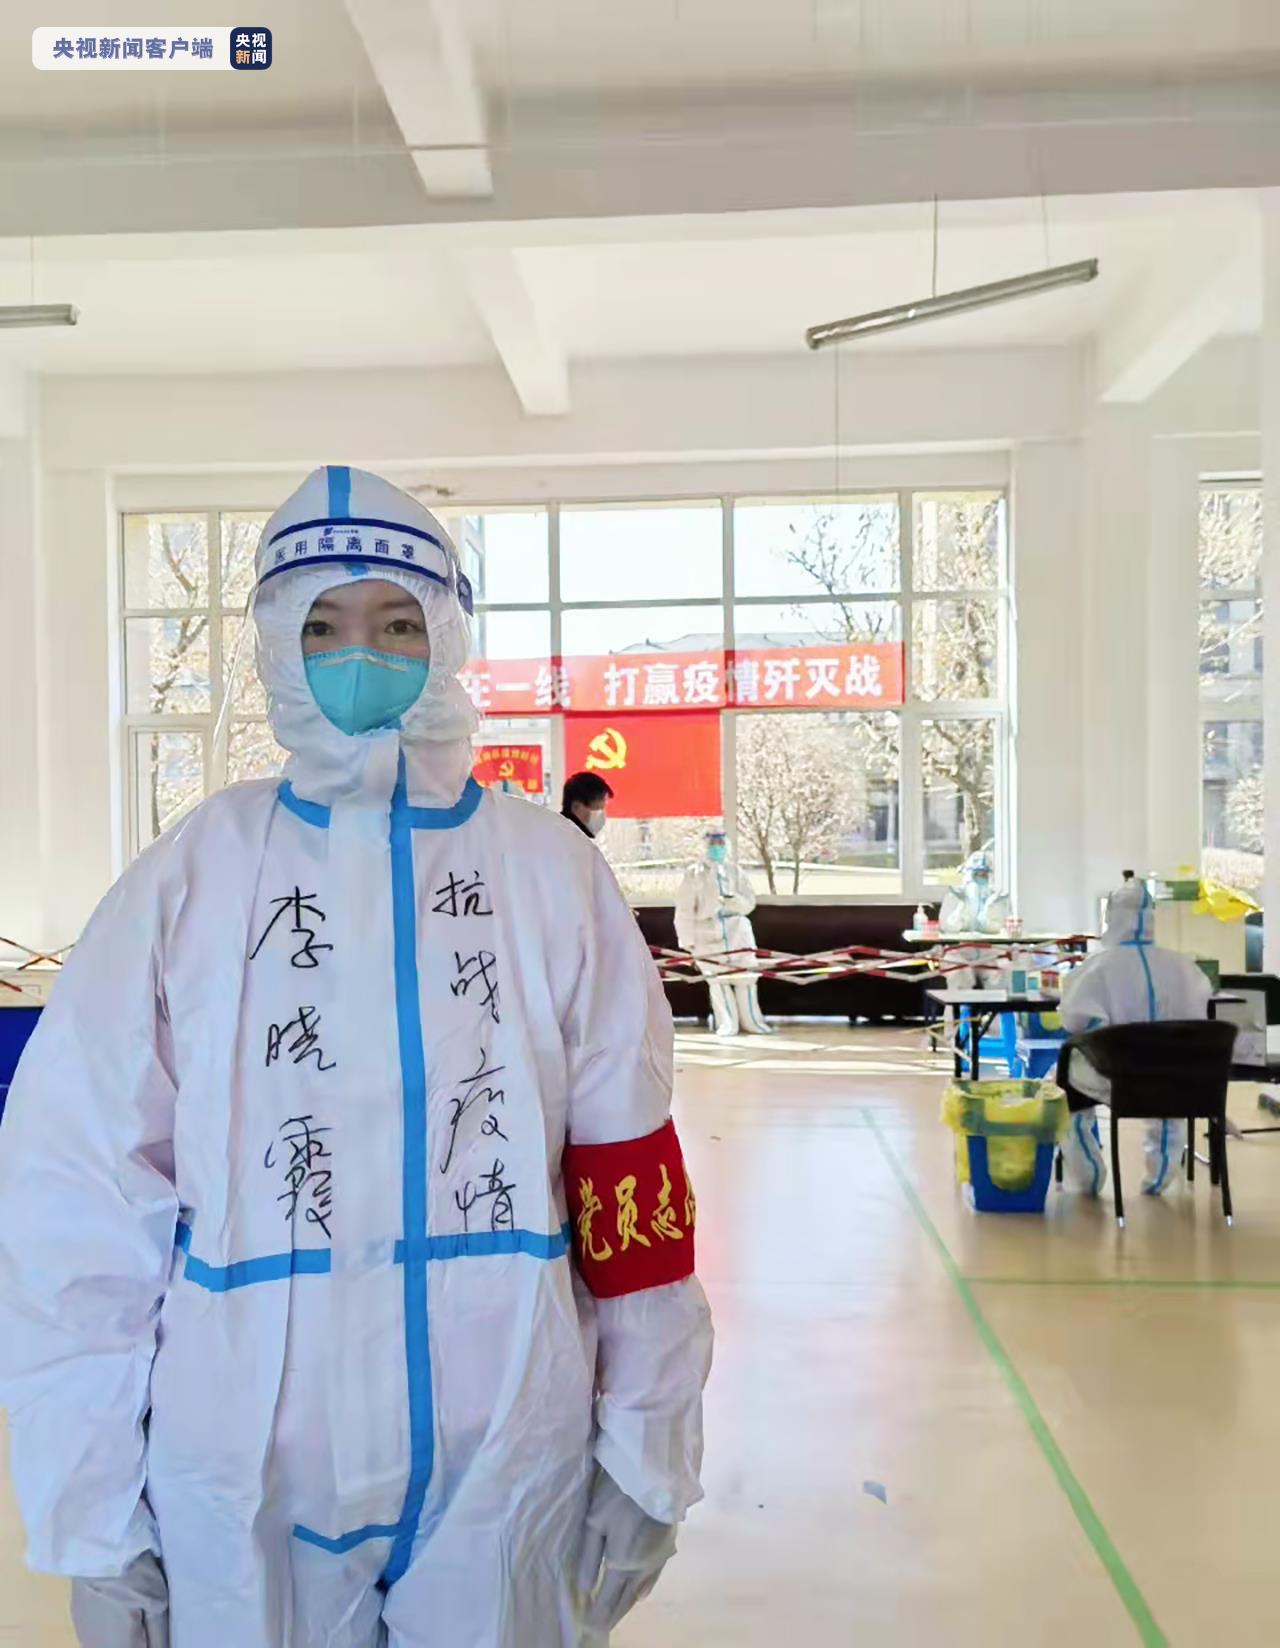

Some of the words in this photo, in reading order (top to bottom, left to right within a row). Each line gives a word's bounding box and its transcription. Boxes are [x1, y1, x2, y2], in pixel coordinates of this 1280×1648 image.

[275, 535, 415, 564] 医用隔离面罩
[604, 654, 883, 706] 打赢疫情歼灭战
[431, 871, 516, 1233] 抗战疫情
